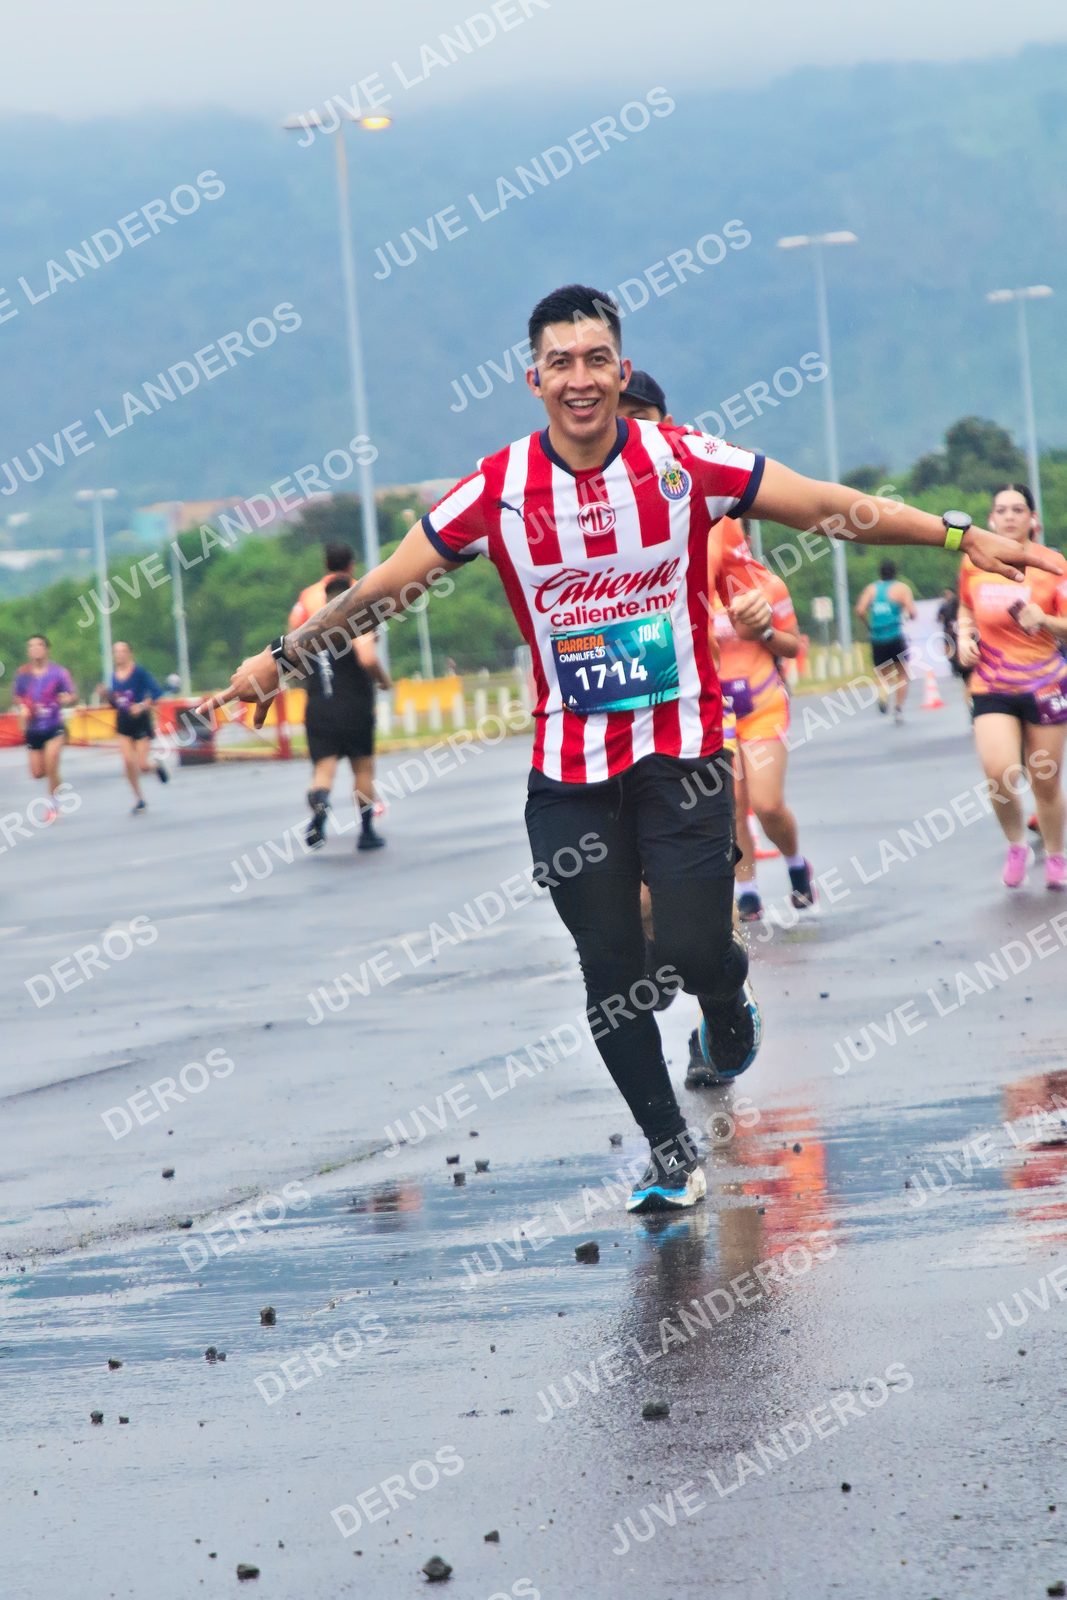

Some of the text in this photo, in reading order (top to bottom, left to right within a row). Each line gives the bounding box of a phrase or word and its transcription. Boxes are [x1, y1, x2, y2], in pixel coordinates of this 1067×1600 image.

[579, 506, 614, 533] MG
[531, 557, 680, 613] Caliente
[551, 588, 677, 627] caliente.mx
[557, 634, 605, 653] CARRERA
[637, 622, 660, 643] 10K
[575, 657, 648, 691] 1714
